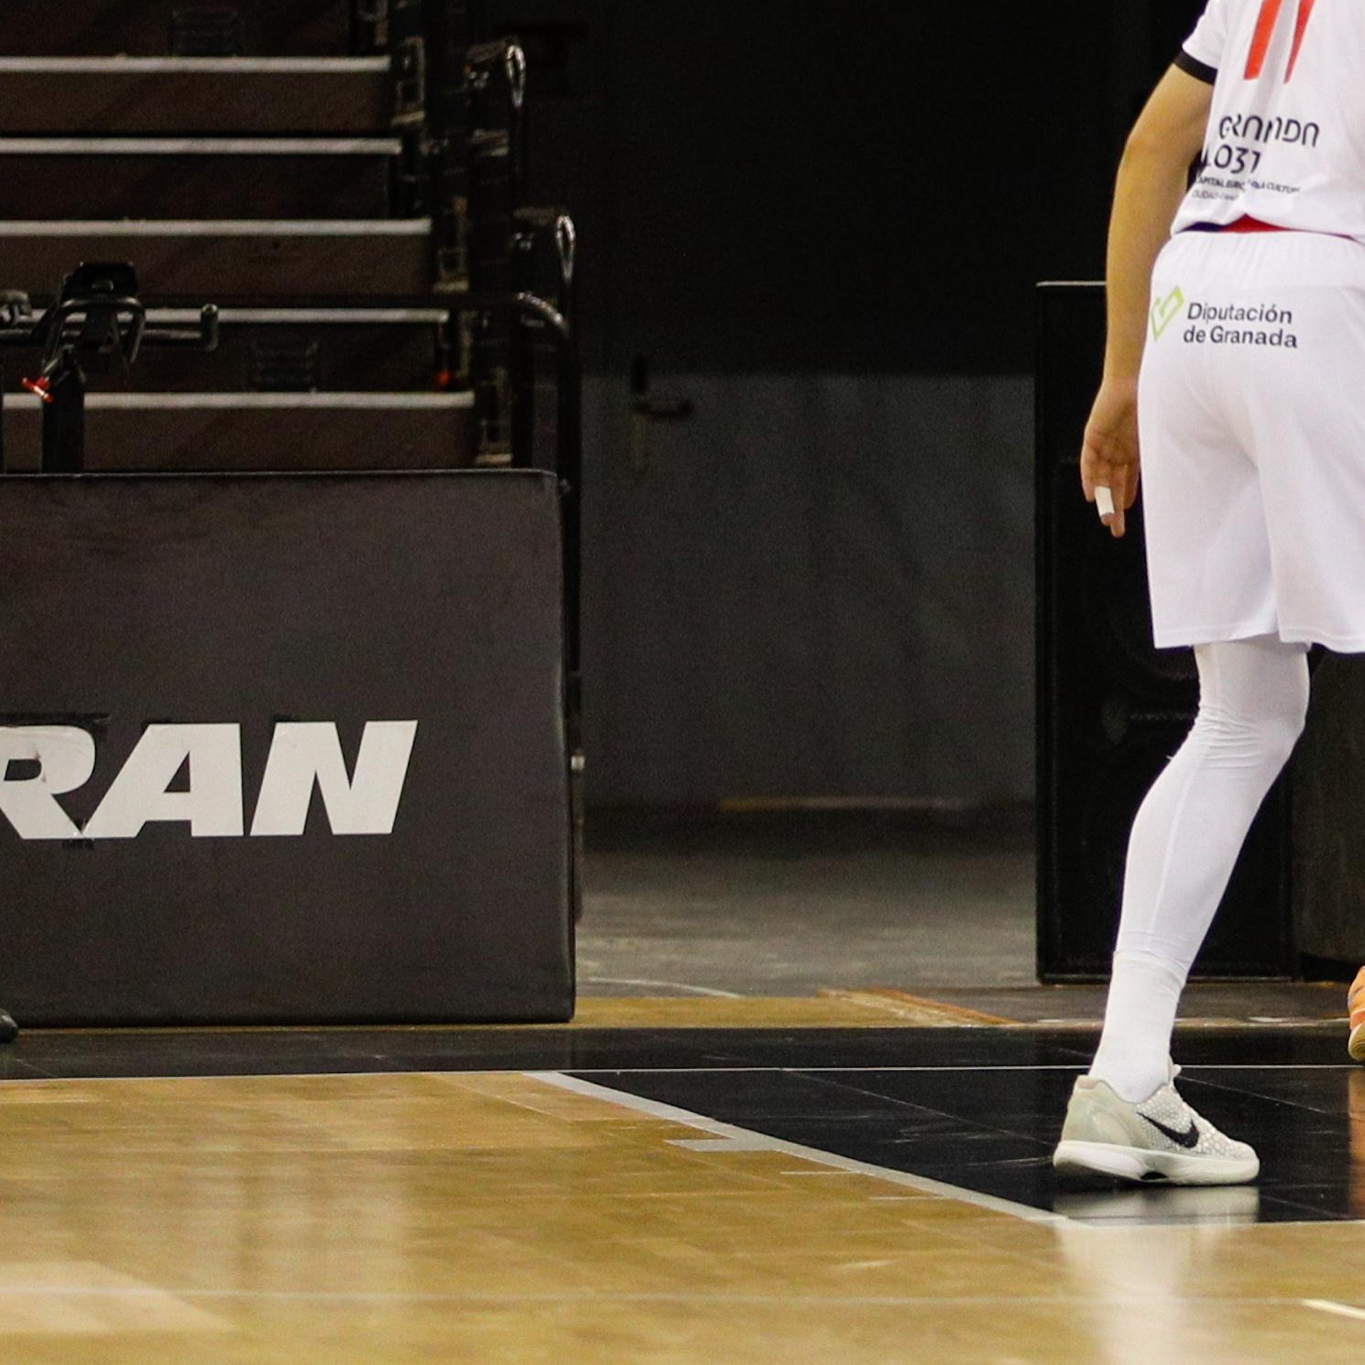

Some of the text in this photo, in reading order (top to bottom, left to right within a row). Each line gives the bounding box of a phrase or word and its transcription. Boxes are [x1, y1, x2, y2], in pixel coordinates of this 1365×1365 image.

[1186, 302, 1293, 326] Diputación
[1183, 325, 1298, 349] de Granada
